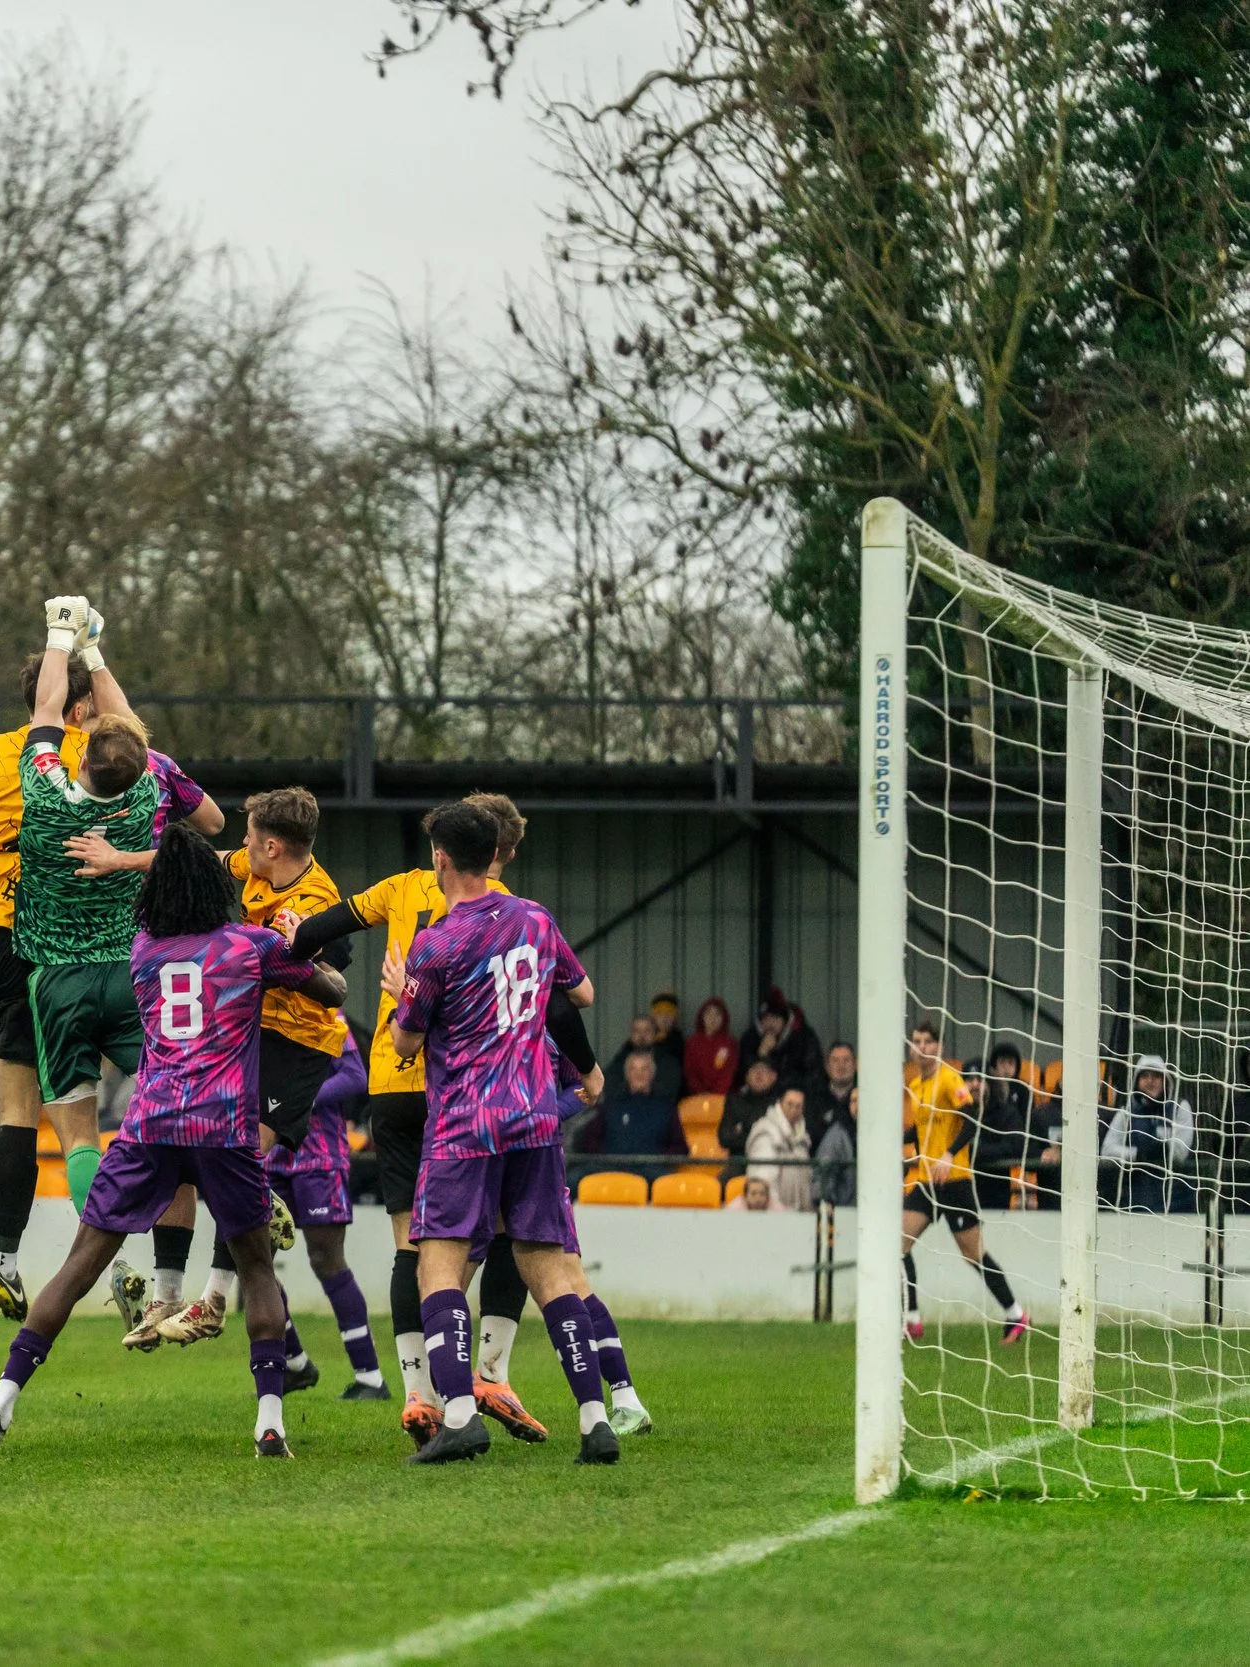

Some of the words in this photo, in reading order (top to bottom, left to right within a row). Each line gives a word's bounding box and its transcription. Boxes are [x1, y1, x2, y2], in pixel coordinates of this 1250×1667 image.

[876, 675, 890, 750] HARROD
[876, 755, 890, 819] SPORT
[159, 961, 204, 1040] 8
[486, 943, 540, 1035] 18
[452, 1309, 470, 1362] SITFC
[562, 1320, 588, 1373] SITFC
